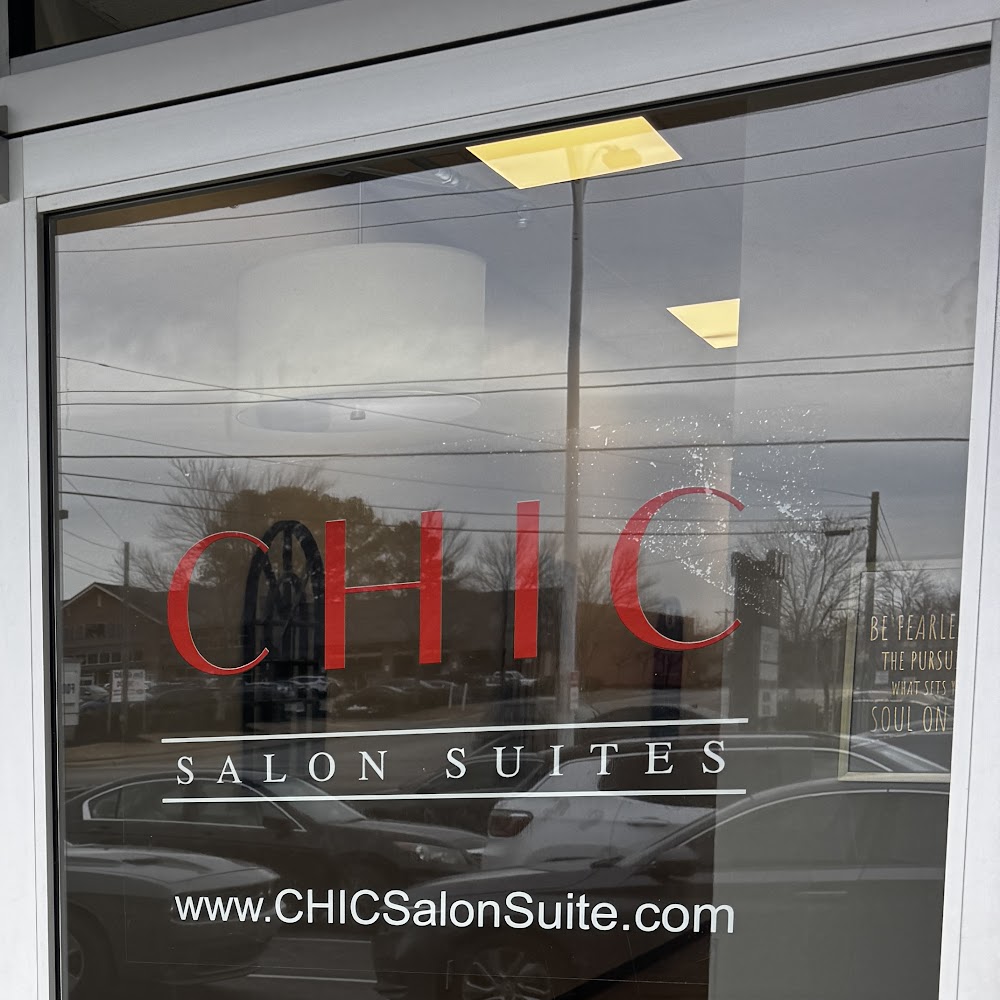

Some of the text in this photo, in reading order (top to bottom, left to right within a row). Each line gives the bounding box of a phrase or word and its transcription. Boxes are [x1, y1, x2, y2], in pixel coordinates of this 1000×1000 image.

[166, 486, 746, 676] CHIC
[869, 613, 956, 641] BE FEARLE
[881, 650, 957, 671] THE PURSU
[891, 680, 920, 696] WHAT
[924, 680, 947, 696] SETS
[870, 705, 948, 733] SOUL ON
[176, 740, 726, 785] SALON SUITES
[174, 888, 735, 934] www.CHICSalonSuite.com
